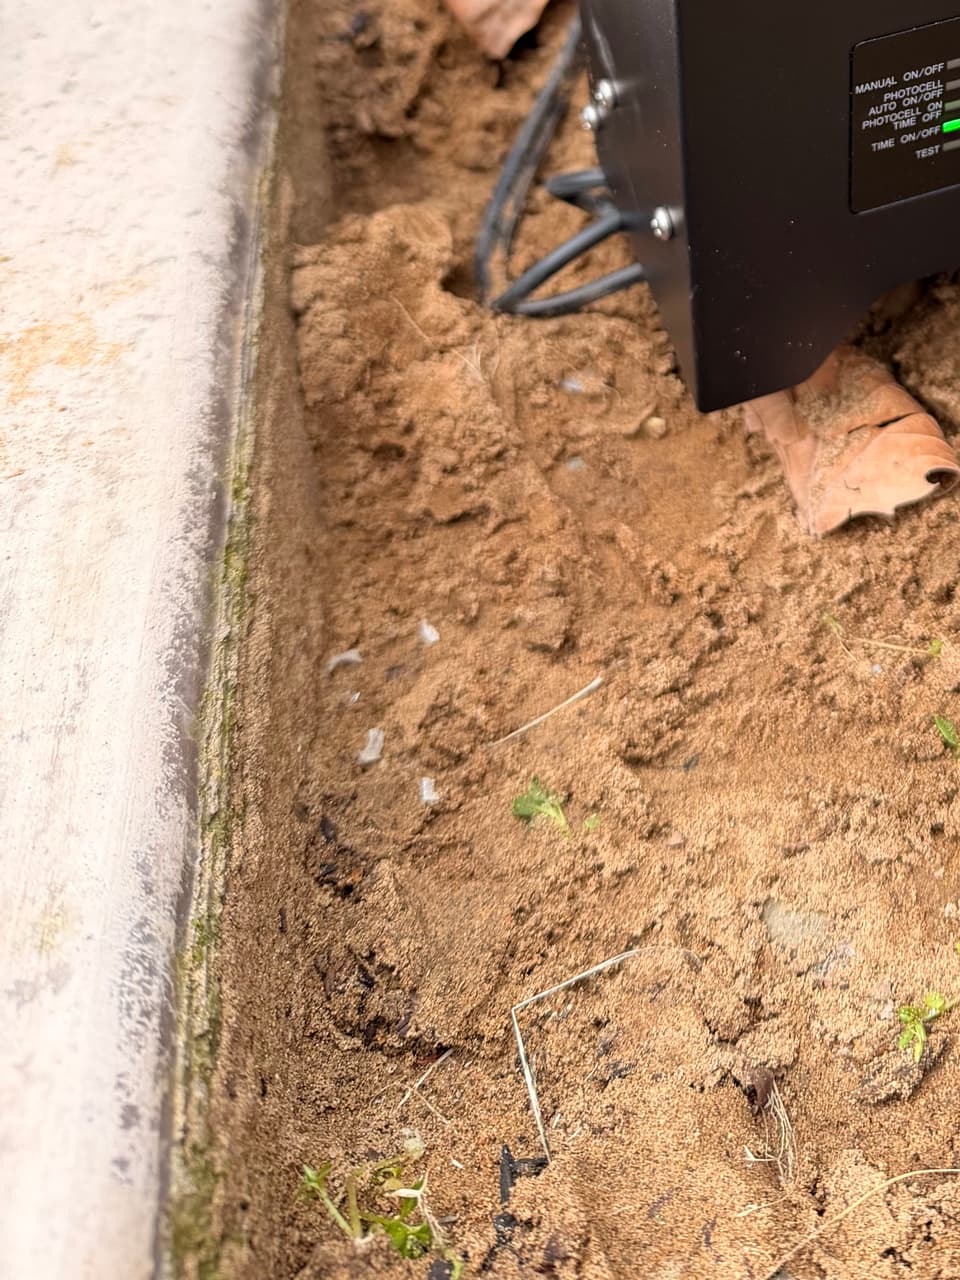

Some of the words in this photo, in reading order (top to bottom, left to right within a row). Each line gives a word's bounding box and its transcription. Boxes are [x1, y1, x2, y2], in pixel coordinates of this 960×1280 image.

[855, 75, 897, 94] MANUAL
[903, 62, 944, 81] ON/OFF
[883, 79, 943, 102] PHOTOCELL
[862, 107, 922, 130] PHOTOCELL
[927, 101, 943, 111] ON
[868, 101, 897, 116] AUTO
[902, 88, 944, 107] ON/OFF
[893, 117, 916, 131] TIME
[922, 110, 942, 122] OFF
[871, 138, 895, 152] TIME
[900, 125, 941, 144] ON/OFF
[915, 145, 940, 159] TEST
